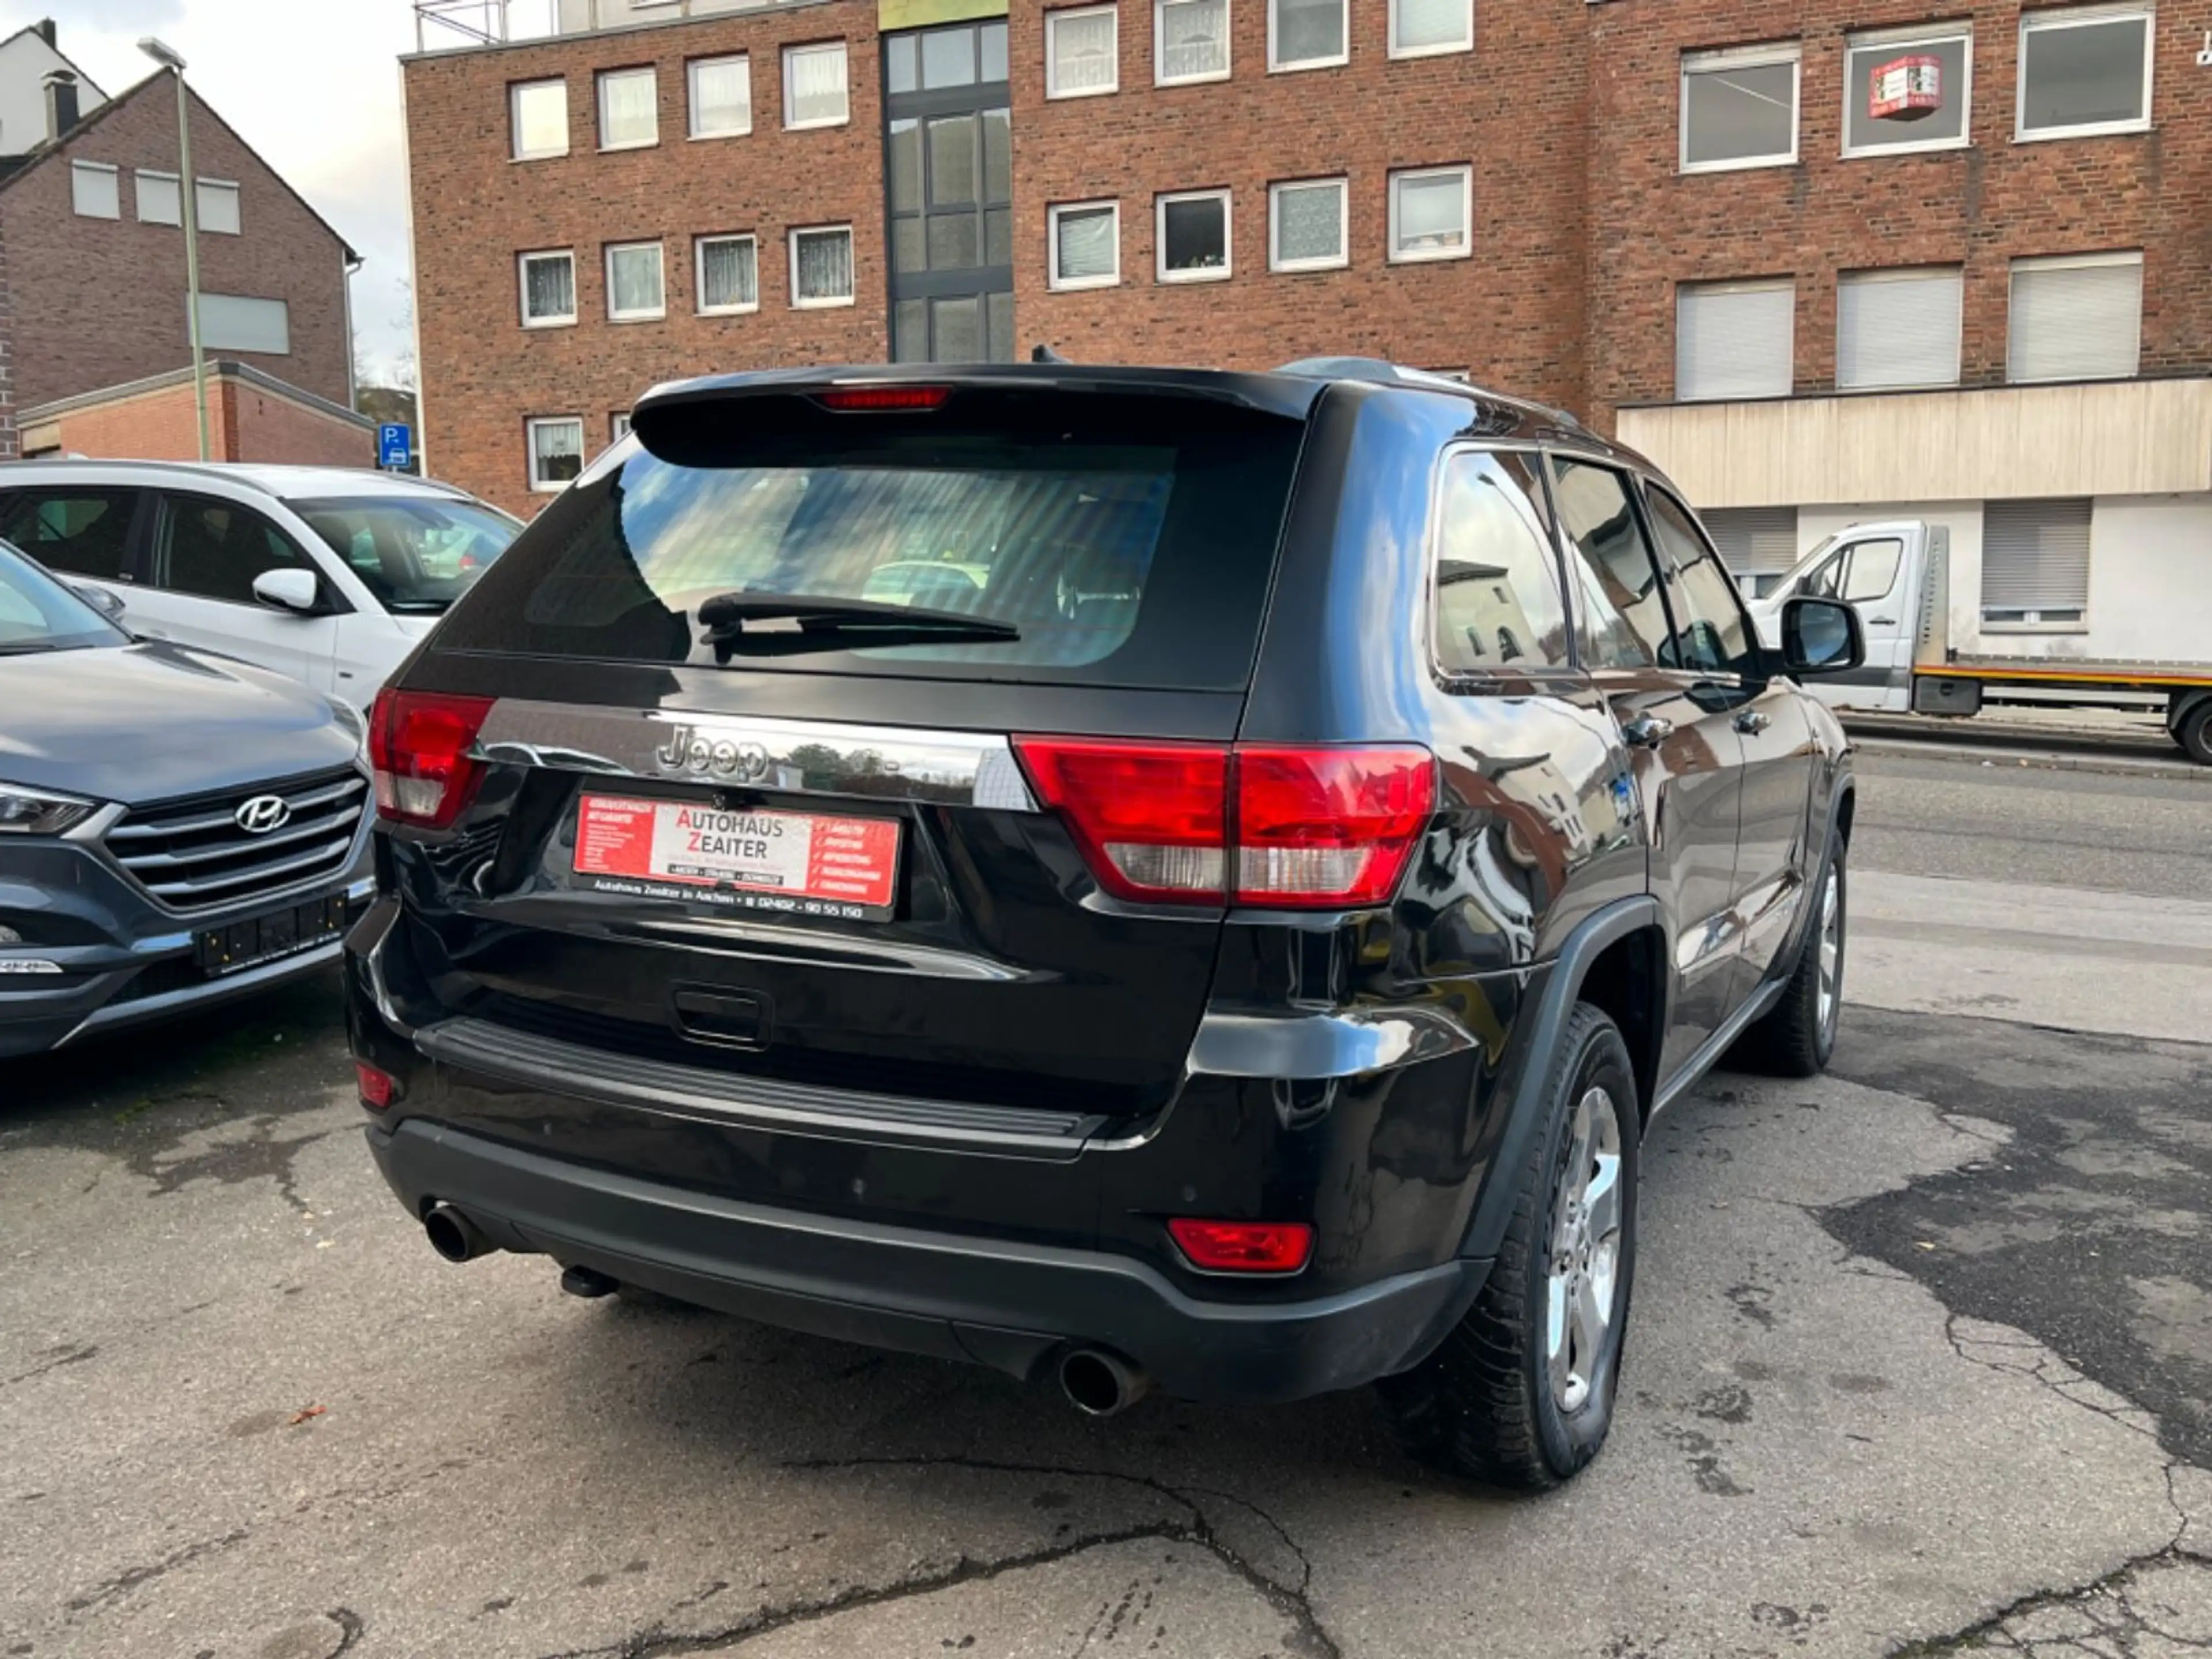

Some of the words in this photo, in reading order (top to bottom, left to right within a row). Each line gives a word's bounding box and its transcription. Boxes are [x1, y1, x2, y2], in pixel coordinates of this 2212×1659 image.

[385, 427, 399, 444] P
[657, 724, 768, 783] Jeep
[676, 809, 783, 838] AUTOHAUS
[687, 831, 767, 859] ZEAITER
